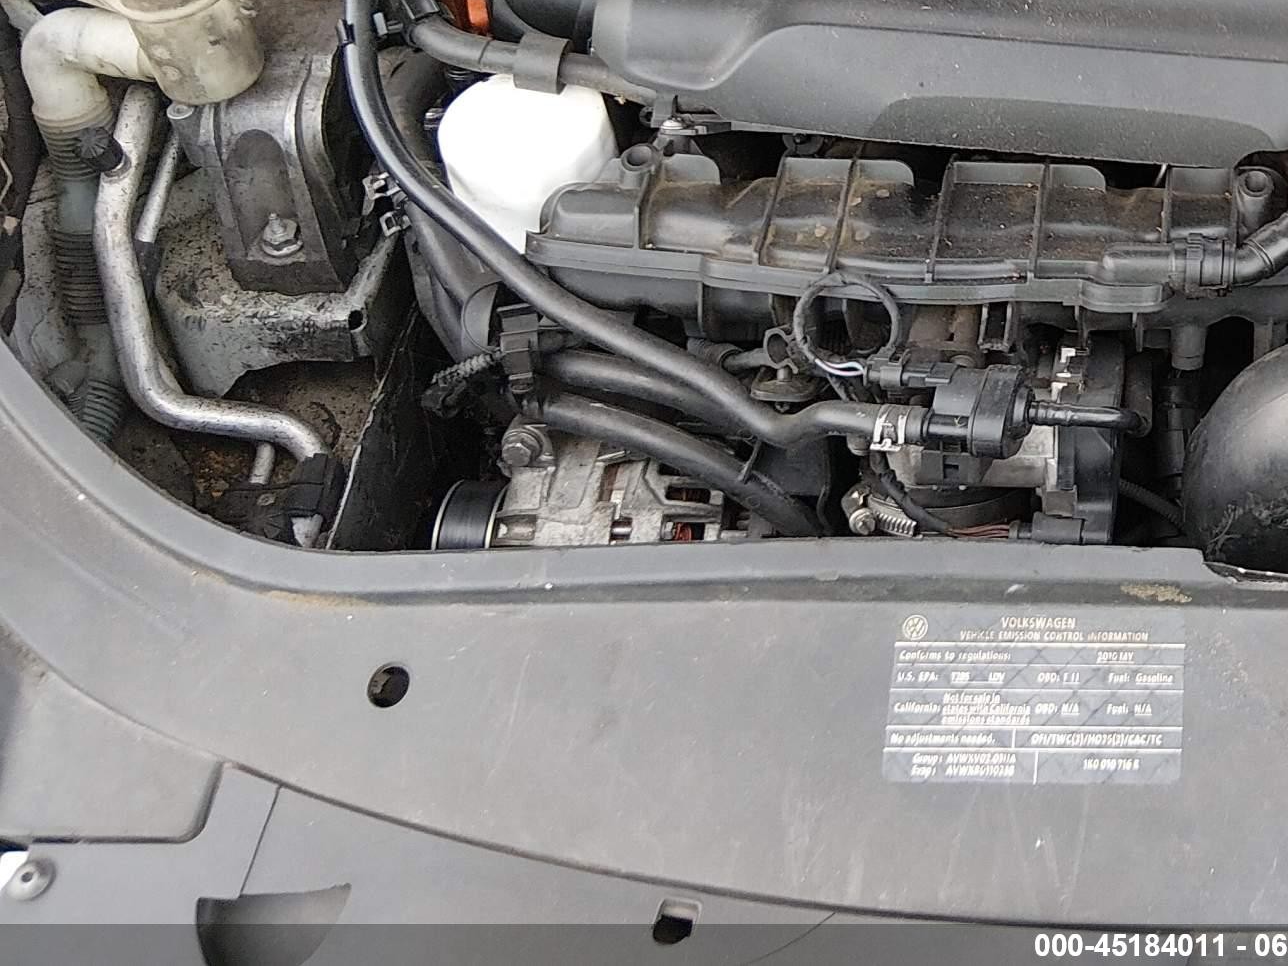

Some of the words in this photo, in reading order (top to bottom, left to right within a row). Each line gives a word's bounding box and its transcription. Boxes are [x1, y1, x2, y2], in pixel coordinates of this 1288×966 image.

[1001, 617, 1076, 629] VOLKSWAGEN
[960, 631, 995, 641] VEHICLE
[998, 631, 1041, 641] EMISSION
[1044, 631, 1084, 641] CONTROL
[1087, 632, 1149, 642] INFORMATION
[898, 649, 942, 661] Conforms
[944, 650, 956, 661] to
[1108, 672, 1130, 683] Fuel:
[1135, 672, 1174, 683] Gasoline
[893, 701, 942, 714] California:
[1061, 703, 1080, 714] N/A
[1134, 703, 1153, 715] N/A
[905, 732, 960, 746] adjustments
